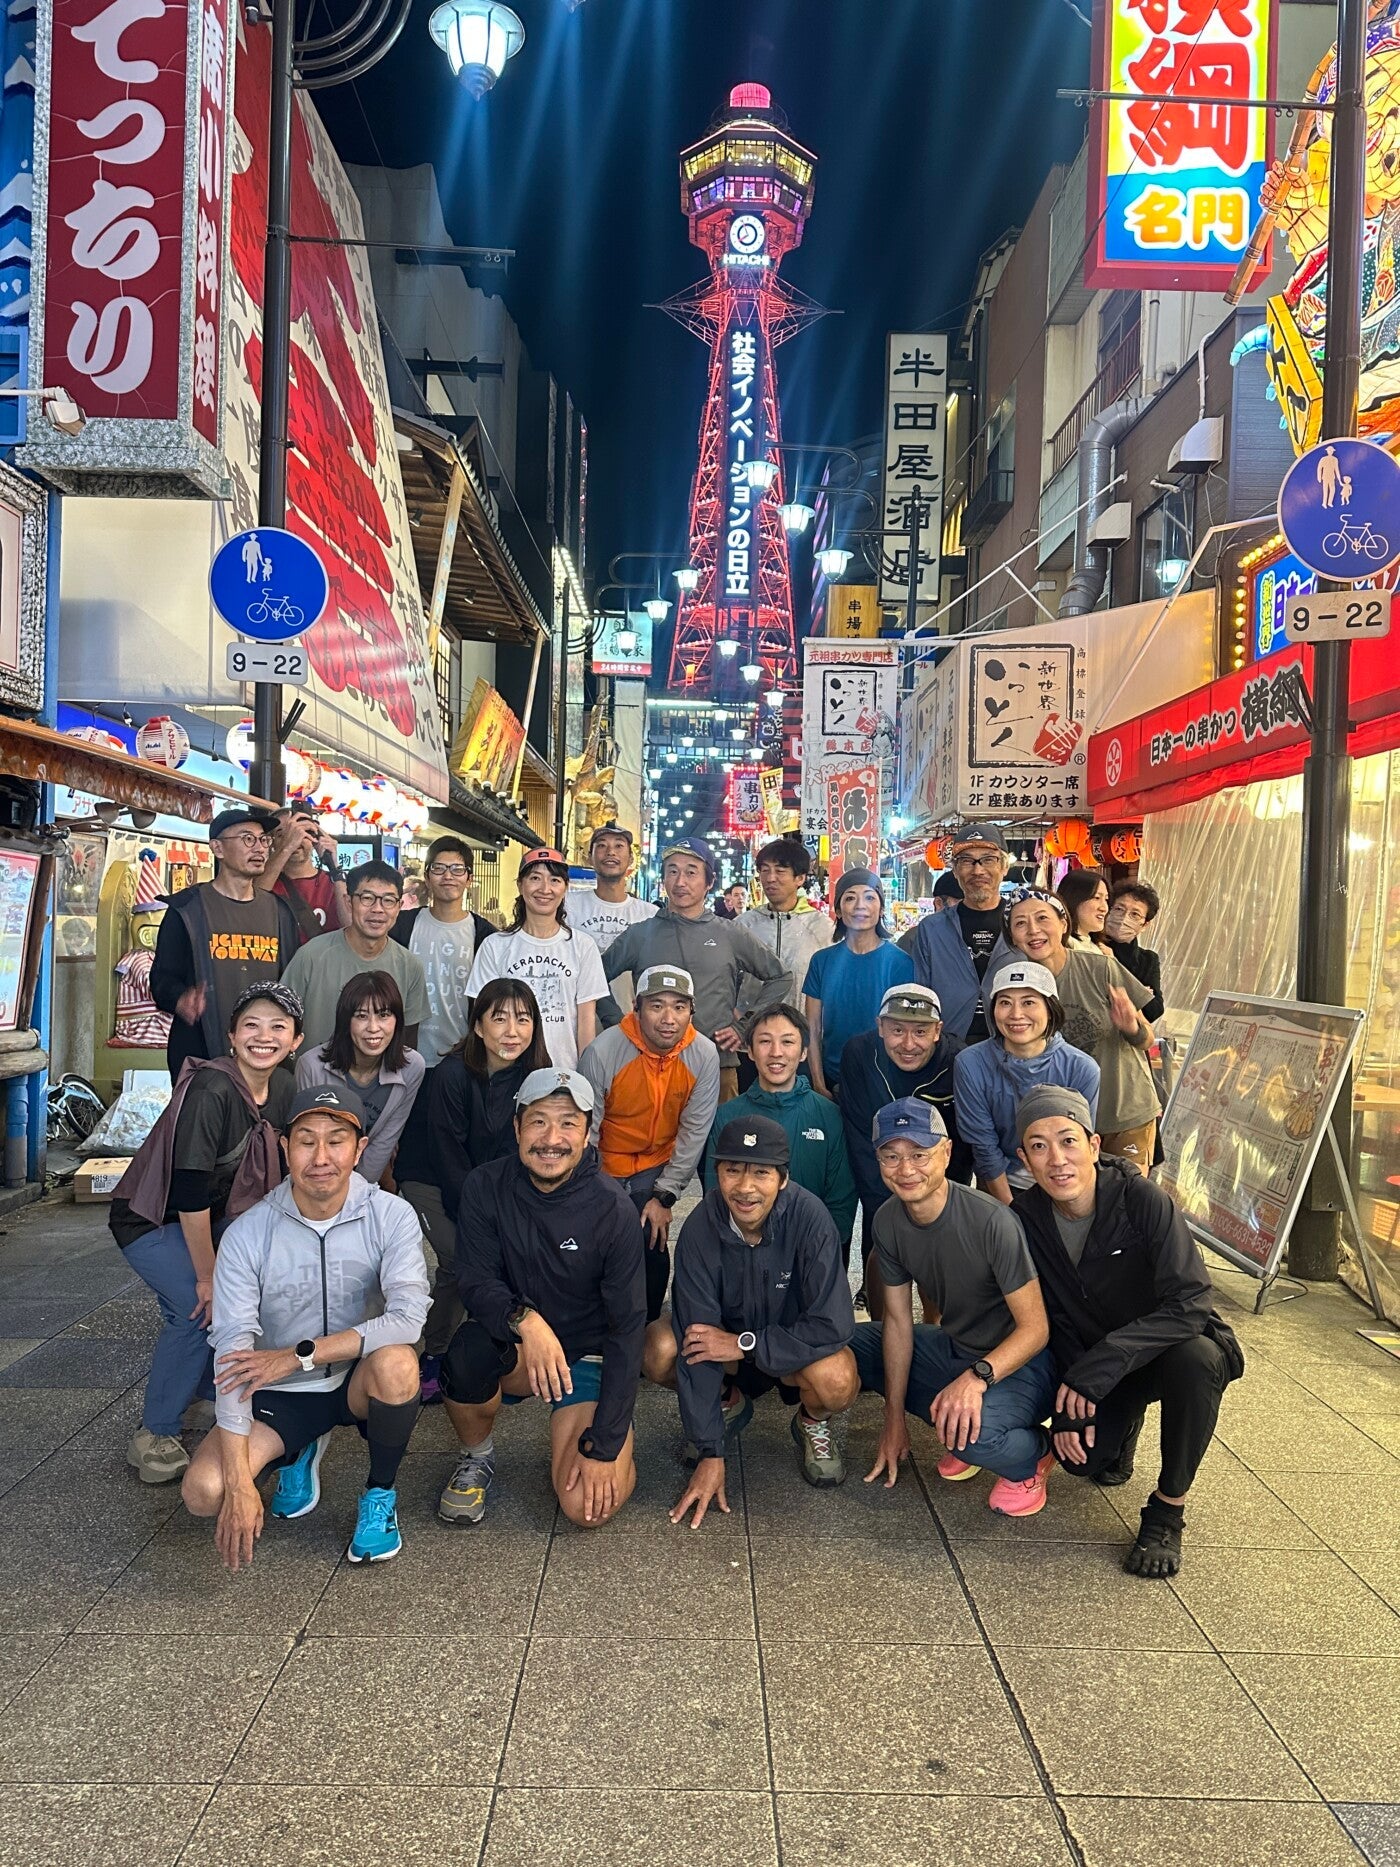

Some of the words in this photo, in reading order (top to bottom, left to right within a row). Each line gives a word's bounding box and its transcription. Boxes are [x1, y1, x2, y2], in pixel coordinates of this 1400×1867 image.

[1127, 0, 1253, 171] 綱
[64, 0, 167, 394] てっちり
[1128, 190, 1245, 245] 名門
[722, 254, 770, 266] HITACHI
[725, 331, 756, 596] 社会イノベーションの日立
[886, 347, 945, 585] 半田屋酒店
[846, 599, 863, 639] 串揚
[809, 650, 894, 663] 元祖串カツ専門店
[1037, 660, 1062, 712] 新世界
[1241, 663, 1305, 740] 横綱
[167, 728, 176, 760] アサヒビール
[1150, 711, 1237, 766] 日本一の串かつ
[744, 781, 759, 813] 串カツ
[969, 775, 985, 788] 1F
[988, 775, 1080, 790] カウンター席
[968, 794, 985, 807] 2F
[988, 794, 1080, 808] 座敷あります
[580, 915, 632, 929] TERADACH
[209, 933, 279, 949] LIGHTING
[210, 946, 249, 961] YOUR
[507, 955, 573, 978] TERADACHO
[545, 1015, 565, 1023] CLUB
